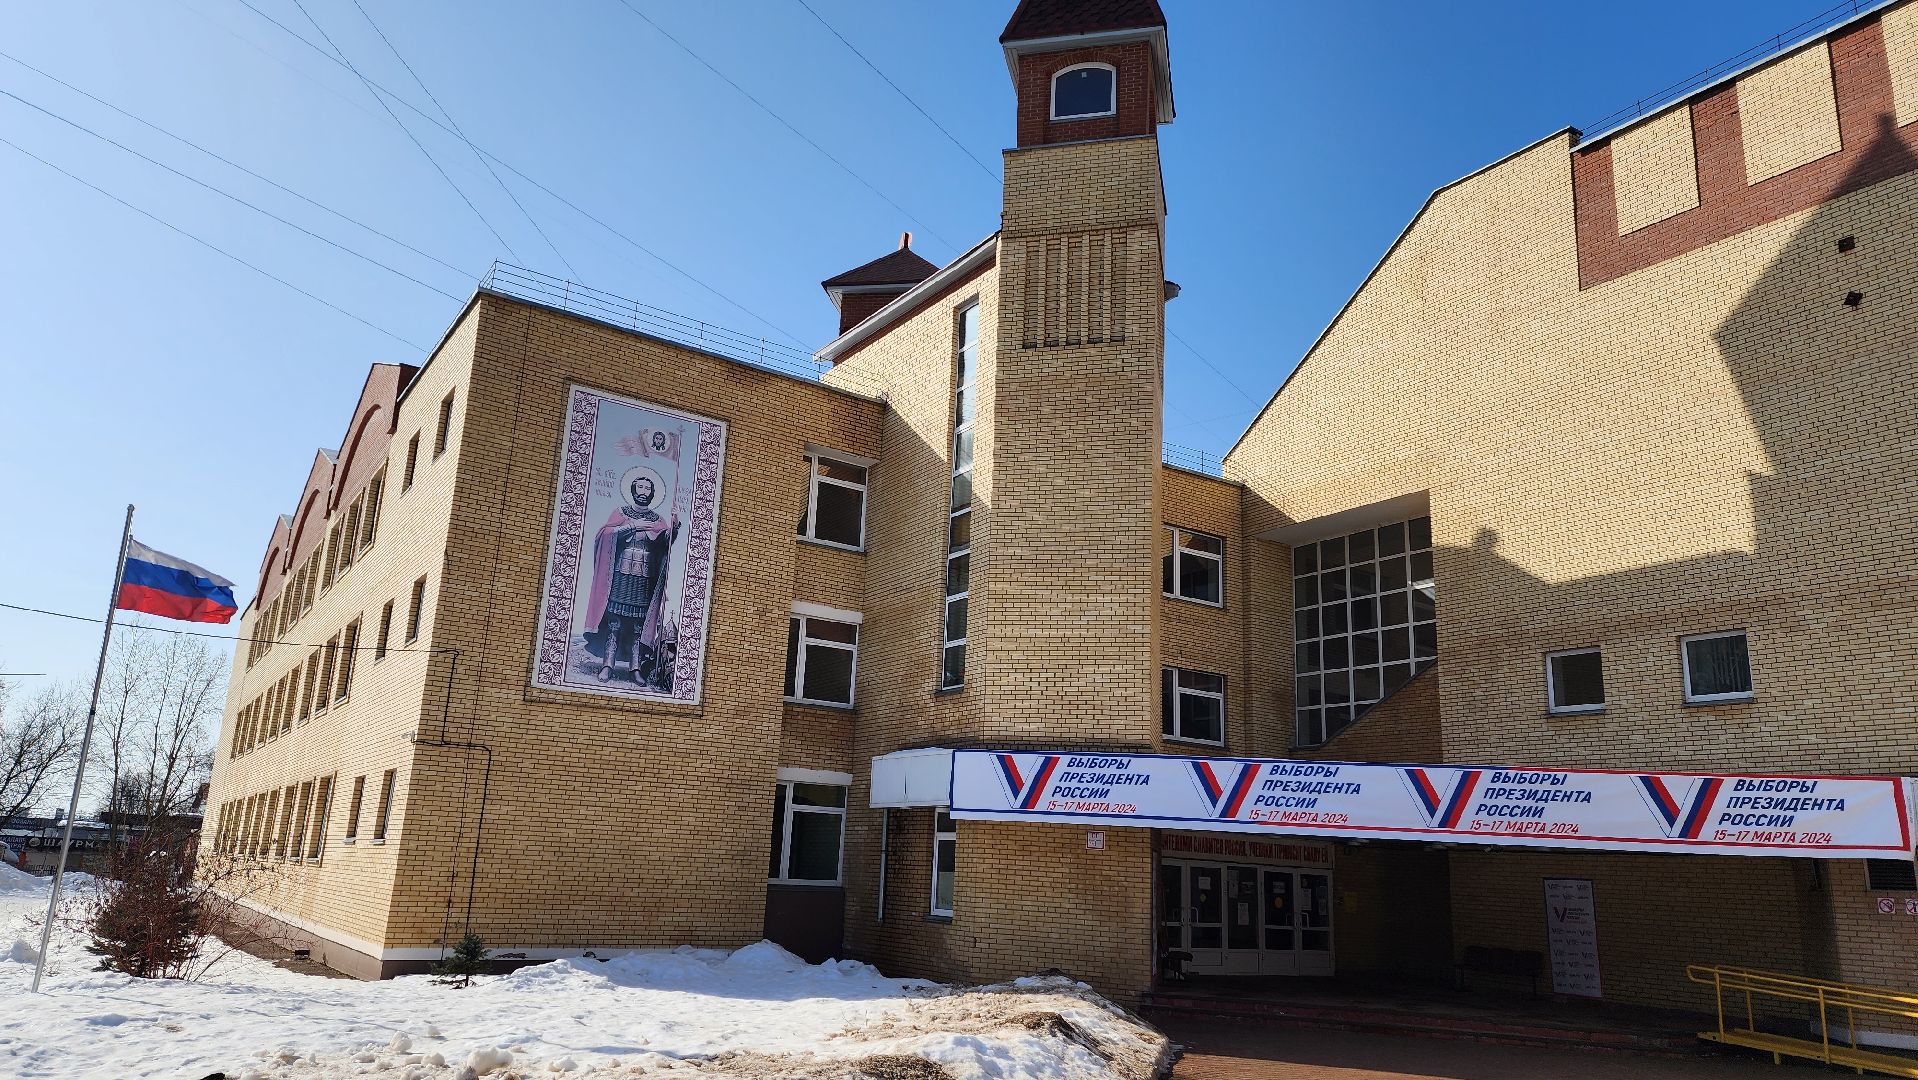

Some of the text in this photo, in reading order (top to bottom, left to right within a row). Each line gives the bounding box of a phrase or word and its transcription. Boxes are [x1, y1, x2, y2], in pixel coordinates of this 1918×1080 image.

[1067, 757, 1132, 770] ВЫБОРЫ
[1269, 764, 1340, 778] ВЫБОРЫ
[1058, 772, 1151, 786] ПРЕЗИДЕНТА
[1490, 771, 1568, 786] ВЫБОРЫ
[1051, 786, 1111, 799] РОССИИ
[1262, 780, 1362, 795] ПРЕЗИДЕНТА
[1733, 779, 1818, 794] ВЫБОРЫ
[1254, 795, 1319, 809] РОССИИ
[1483, 788, 1592, 804] ПРЕЗИДЕНТА
[1075, 802, 1110, 813] МАРТА
[1111, 804, 1137, 814] 2024
[1475, 803, 1546, 819] РОССИИ
[1726, 796, 1846, 812] ПРЕЗИДЕНТА
[1280, 811, 1319, 823] МАРТА
[1321, 813, 1349, 824] 2024
[1718, 813, 1795, 828] РОССИИ
[1504, 820, 1546, 834] МАРТА
[1549, 823, 1579, 835] 2024
[1751, 830, 1796, 844] МАРТА
[1799, 832, 1832, 845] 2024
